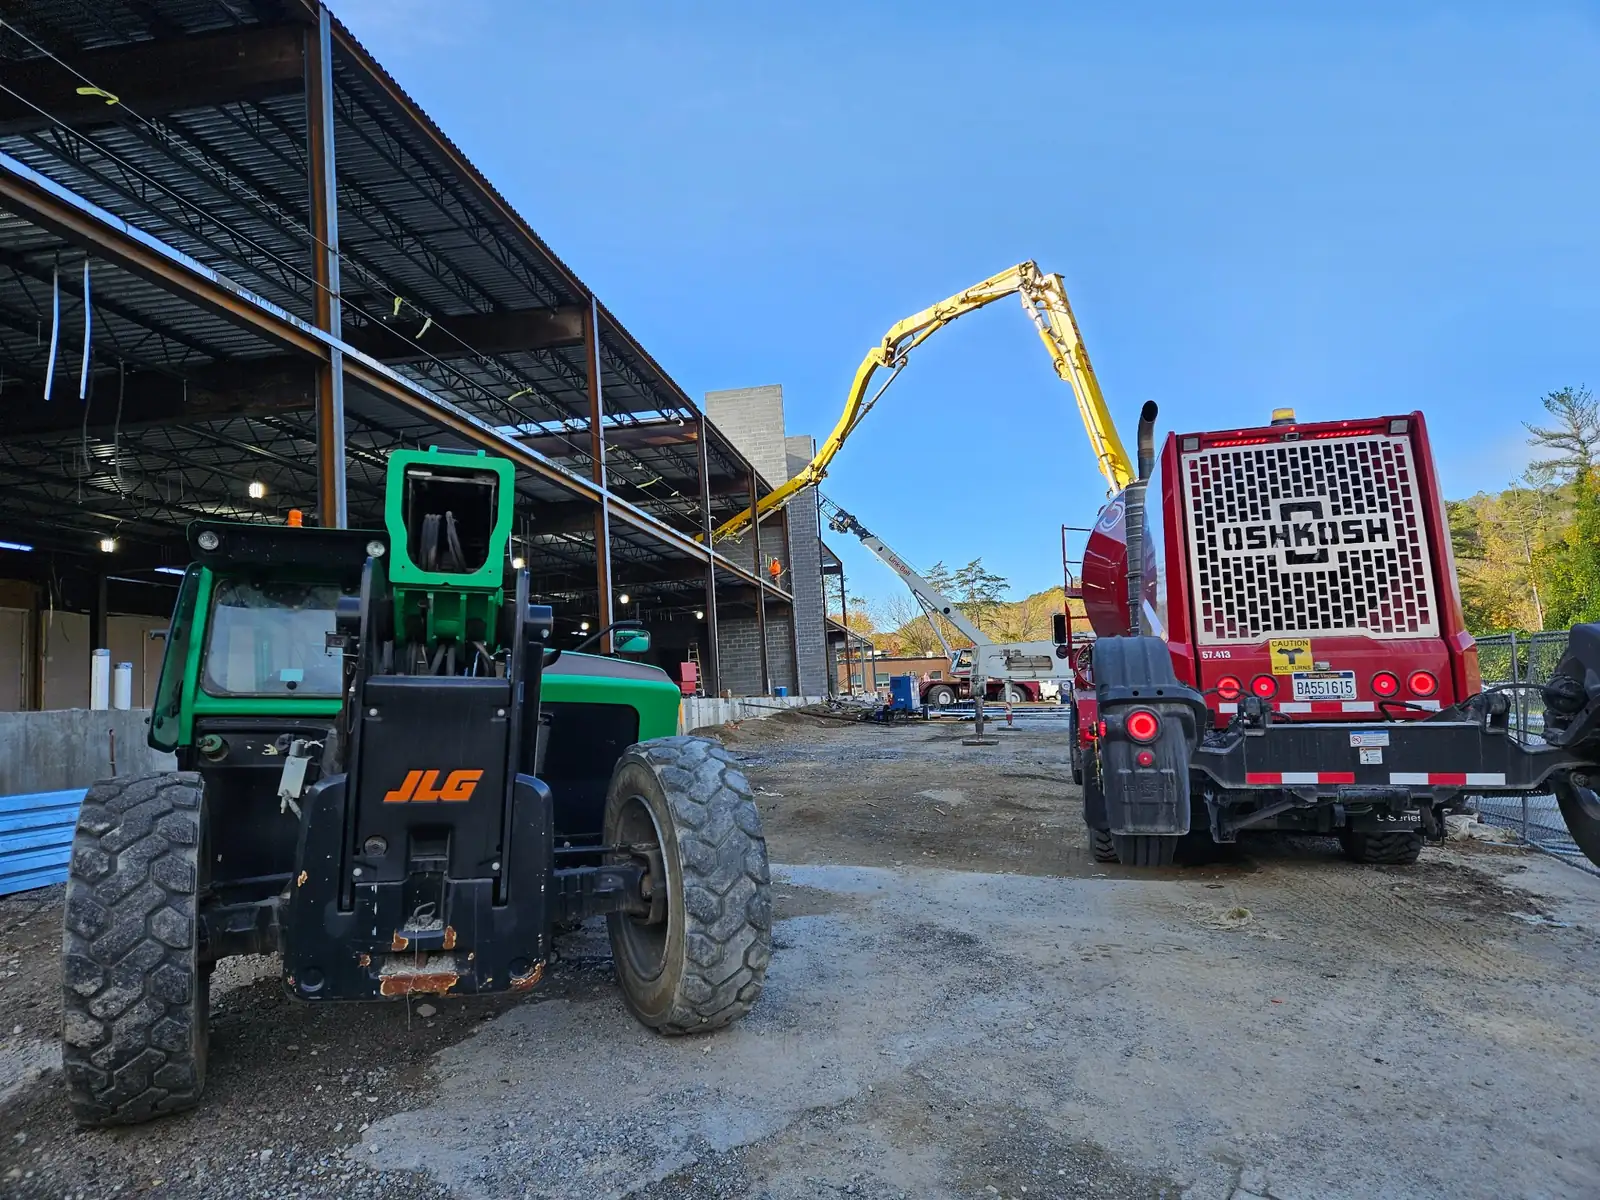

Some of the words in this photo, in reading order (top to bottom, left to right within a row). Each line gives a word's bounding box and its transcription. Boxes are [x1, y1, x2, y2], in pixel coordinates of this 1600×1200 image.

[1222, 518, 1390, 551] OSHKOSH
[1271, 639, 1309, 647] CAUTION
[1201, 650, 1231, 659] 57.413
[1296, 681, 1353, 695] BA551615
[383, 769, 485, 803] JLG
